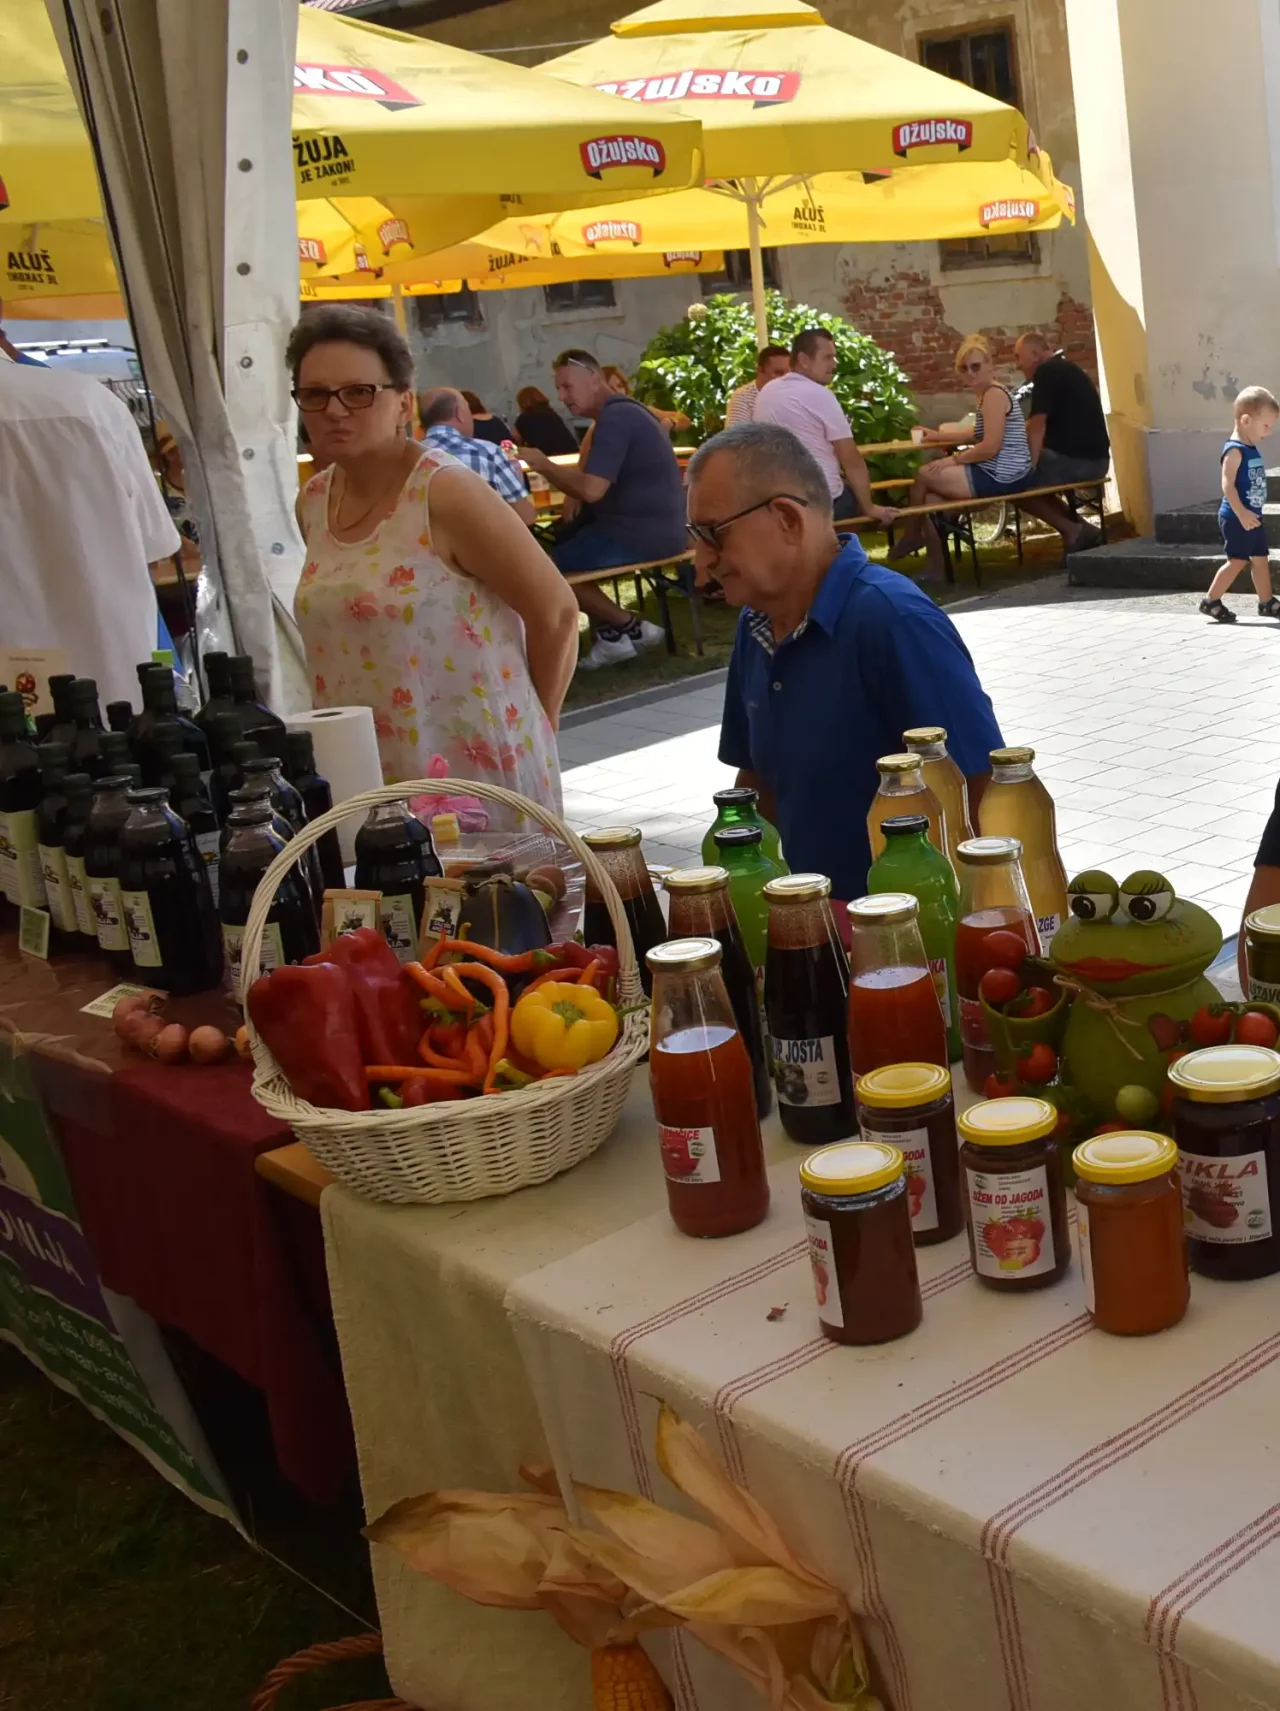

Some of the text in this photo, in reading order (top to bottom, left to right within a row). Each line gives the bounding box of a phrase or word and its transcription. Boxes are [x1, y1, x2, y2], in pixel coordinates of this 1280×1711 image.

[900, 120, 967, 147] Ožujsko
[292, 135, 349, 167] ŽUJA
[587, 137, 660, 168] Ožujsko
[300, 170, 313, 184] JE
[314, 159, 356, 179] ZAKON!
[786, 1040, 823, 1063] JOSTA
[973, 1188, 1044, 1205] DŽEM OD JAGODA
